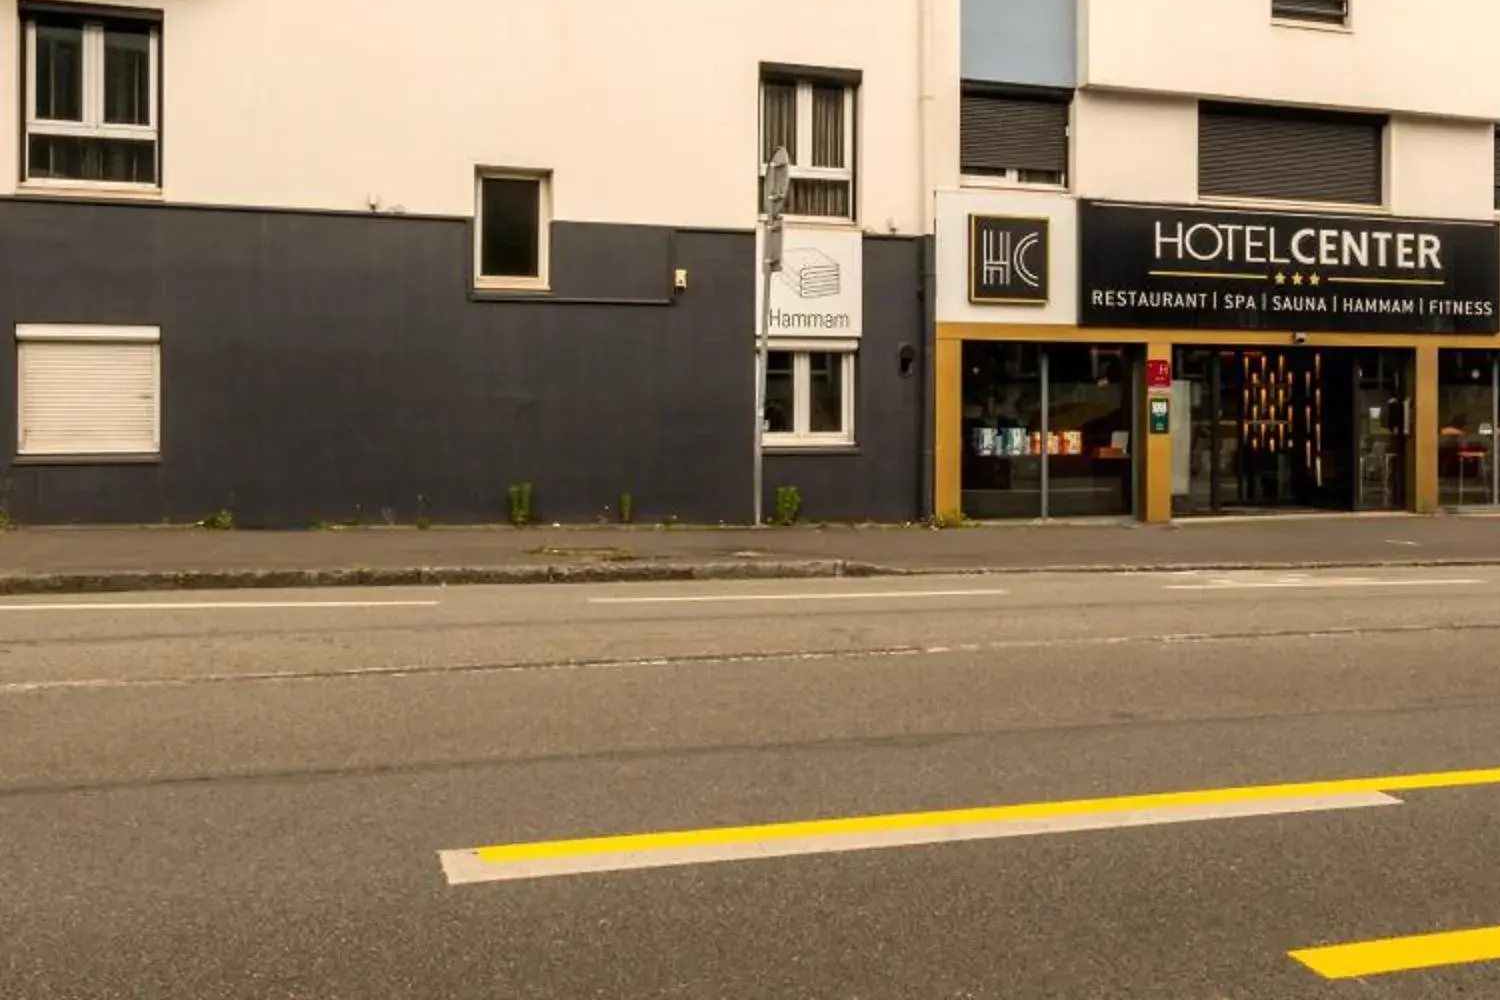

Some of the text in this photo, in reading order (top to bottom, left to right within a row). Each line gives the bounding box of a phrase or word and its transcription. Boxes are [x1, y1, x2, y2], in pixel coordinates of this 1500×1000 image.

[1091, 289, 1493, 316] RESTAURANT SPA SAUNA HAMMAM FITNESS
[768, 308, 850, 329] Hammam
